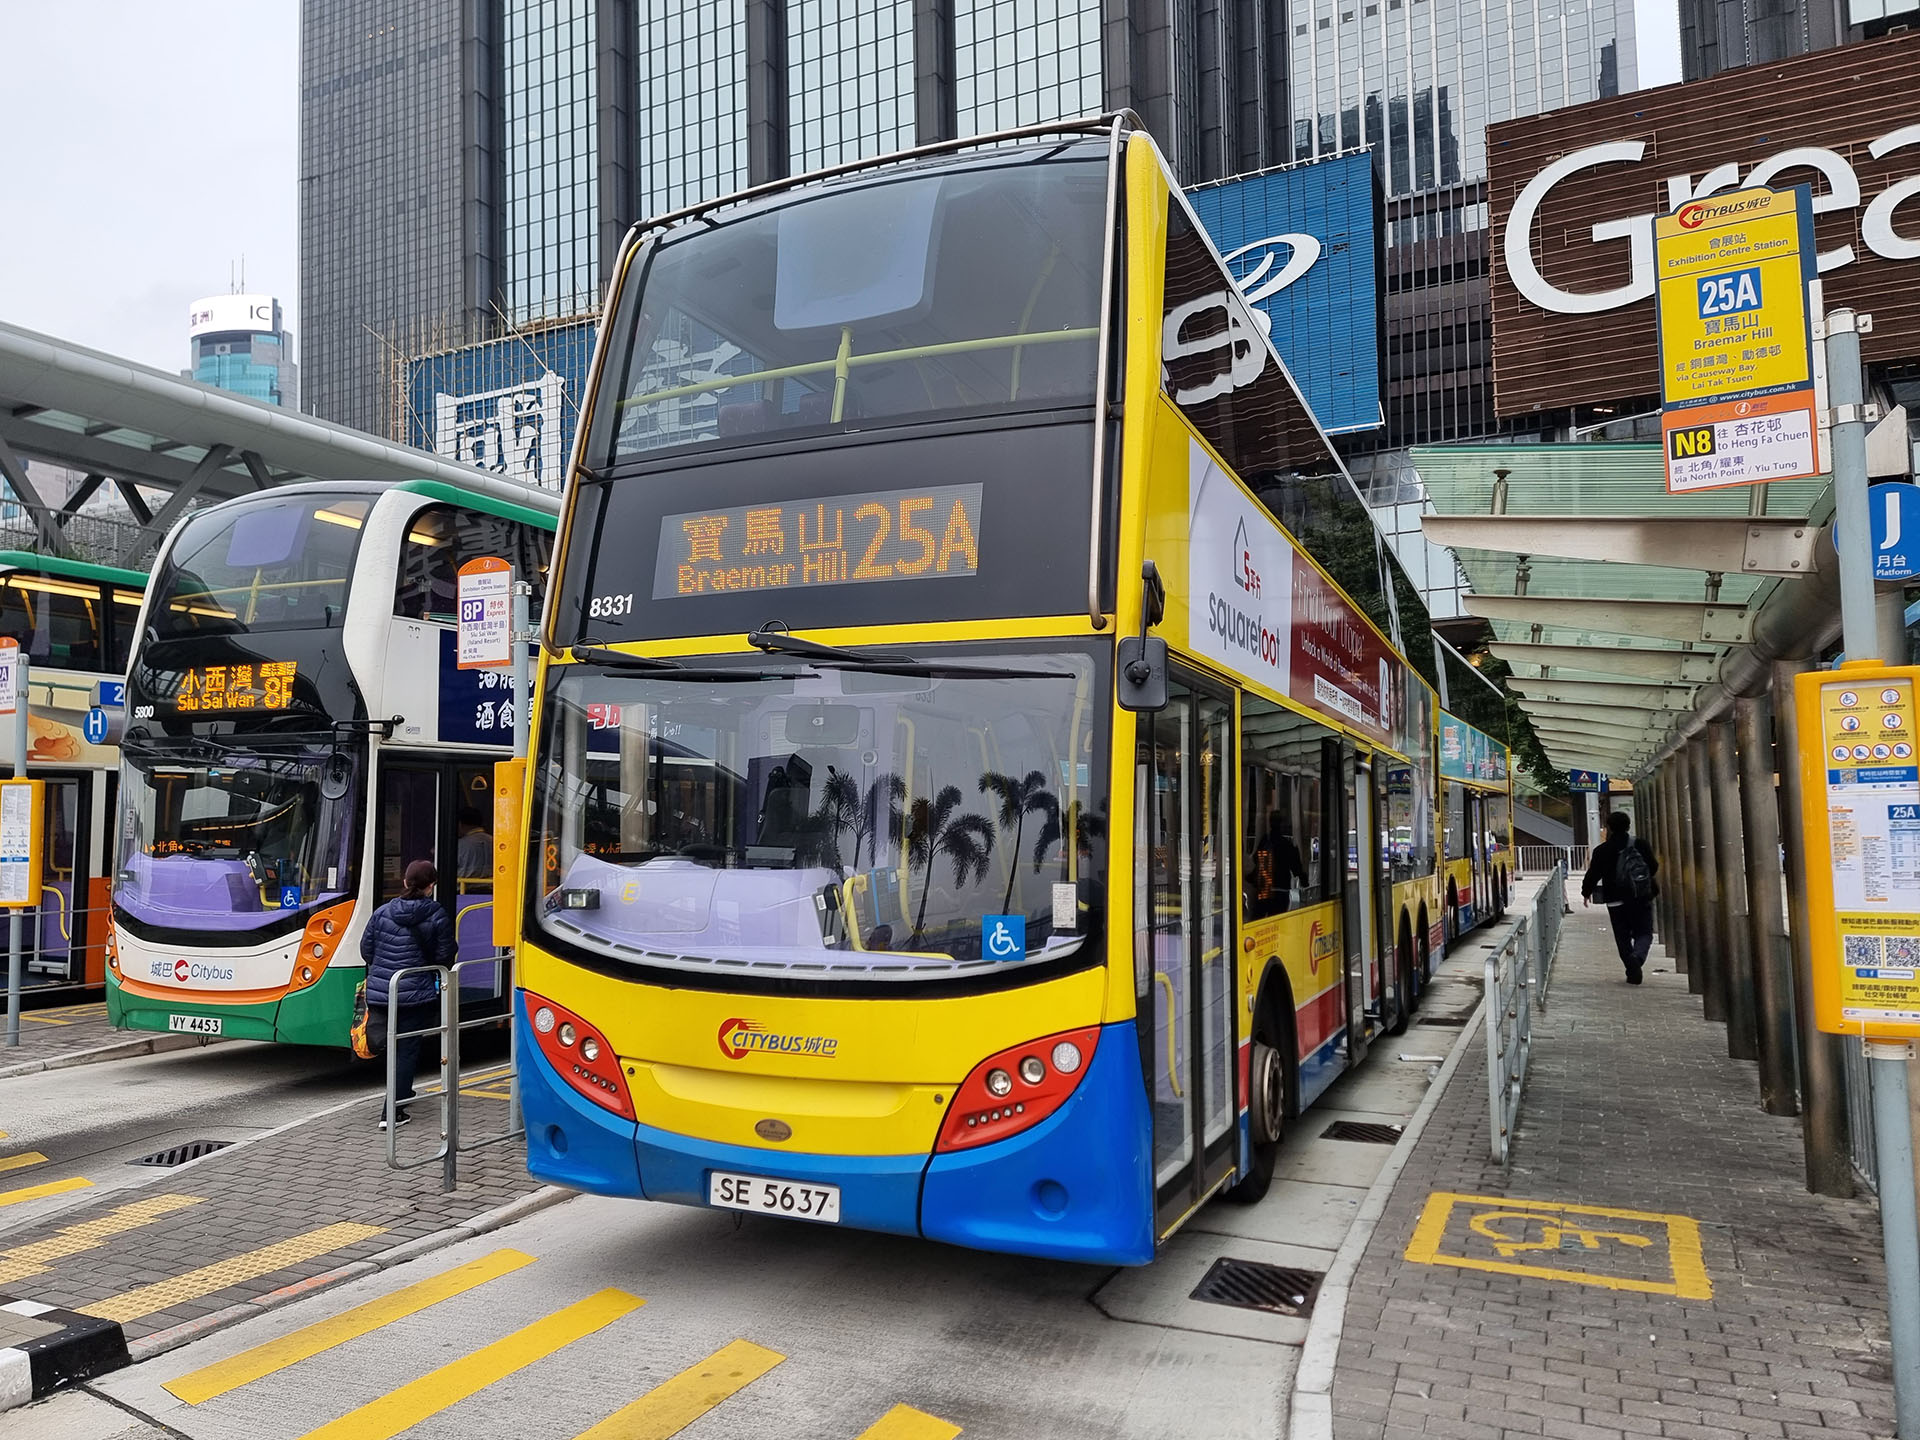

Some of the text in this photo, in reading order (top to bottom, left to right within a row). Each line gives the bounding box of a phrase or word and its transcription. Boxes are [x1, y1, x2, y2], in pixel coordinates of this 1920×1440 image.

[1692, 196, 1771, 221] CITYBUS 城巴
[1709, 232, 1747, 249] 會展站
[1668, 238, 1789, 268] Exhibition Centre Station
[1701, 273, 1759, 315] 25A
[1704, 313, 1760, 336] 寶馬山
[1694, 327, 1773, 350] Braemar Hill
[1691, 367, 1736, 380] Causeway
[1738, 363, 1758, 374] Bay,
[1692, 375, 1753, 390] Lai Tak Tsuen
[1720, 383, 1796, 401] www.citybus.com.hk
[1717, 417, 1782, 439] 往 杏花邨
[1675, 430, 1712, 457] N8
[1717, 431, 1809, 450] to Heng Fa Chuen
[1675, 475, 1687, 483] via
[1690, 470, 1717, 482] North
[1720, 468, 1744, 478] Point
[1755, 464, 1770, 473] Yiu
[1773, 461, 1798, 471] Tung
[1880, 492, 1900, 550] J
[682, 503, 842, 563] 寶馬山
[852, 497, 979, 579] 25A
[1877, 554, 1906, 567] 月台
[677, 550, 847, 595] Braemar Hill
[1876, 568, 1912, 577] Platform
[464, 601, 482, 620] 8P
[589, 593, 634, 617] 8331
[1209, 592, 1280, 669] squarefoot
[181, 664, 253, 694] 小西灣
[134, 705, 154, 719] 5800
[178, 692, 255, 711] Siu Sai Wan
[90, 711, 101, 735] H
[1892, 806, 1916, 819] 25A
[151, 961, 233, 981] 城巴 Citybus
[173, 1016, 219, 1033] VY 4453
[732, 1031, 838, 1055] CITYBUS 城巴
[719, 1177, 830, 1216] SE 5637
